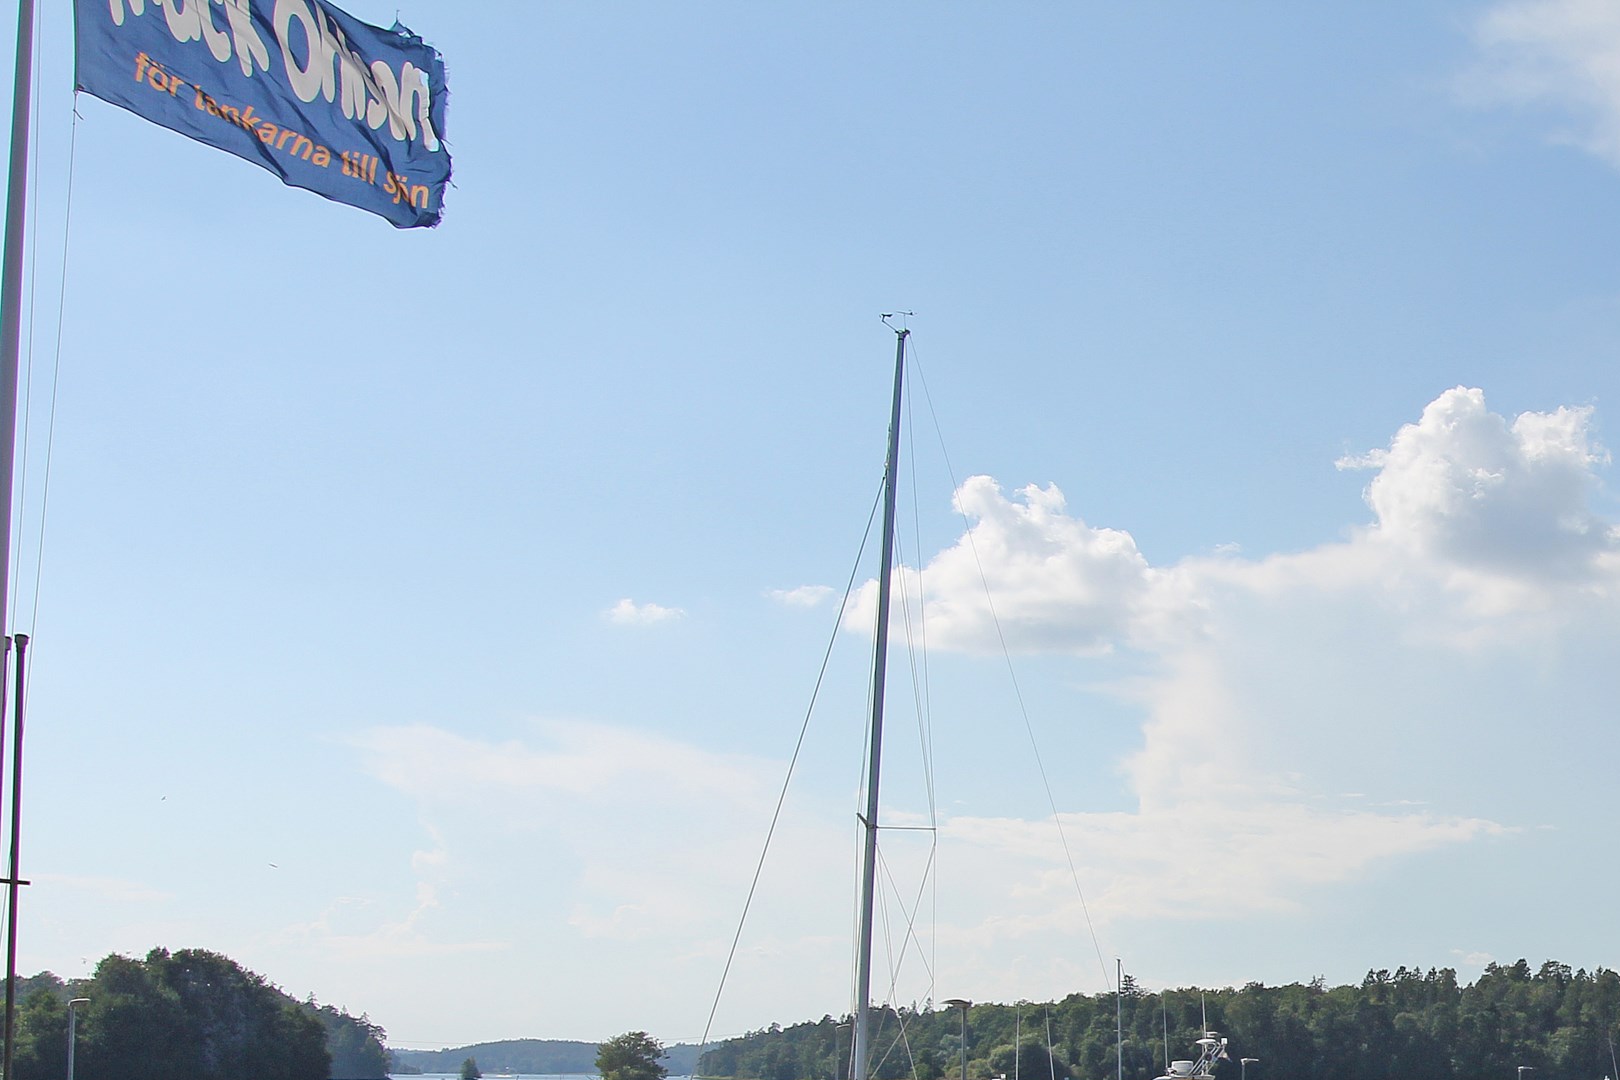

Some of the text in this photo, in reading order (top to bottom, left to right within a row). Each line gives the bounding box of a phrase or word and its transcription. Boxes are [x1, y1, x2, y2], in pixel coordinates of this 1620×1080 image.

[135, 51, 185, 97] för
[194, 84, 331, 168] tankarna
[341, 150, 379, 185] till
